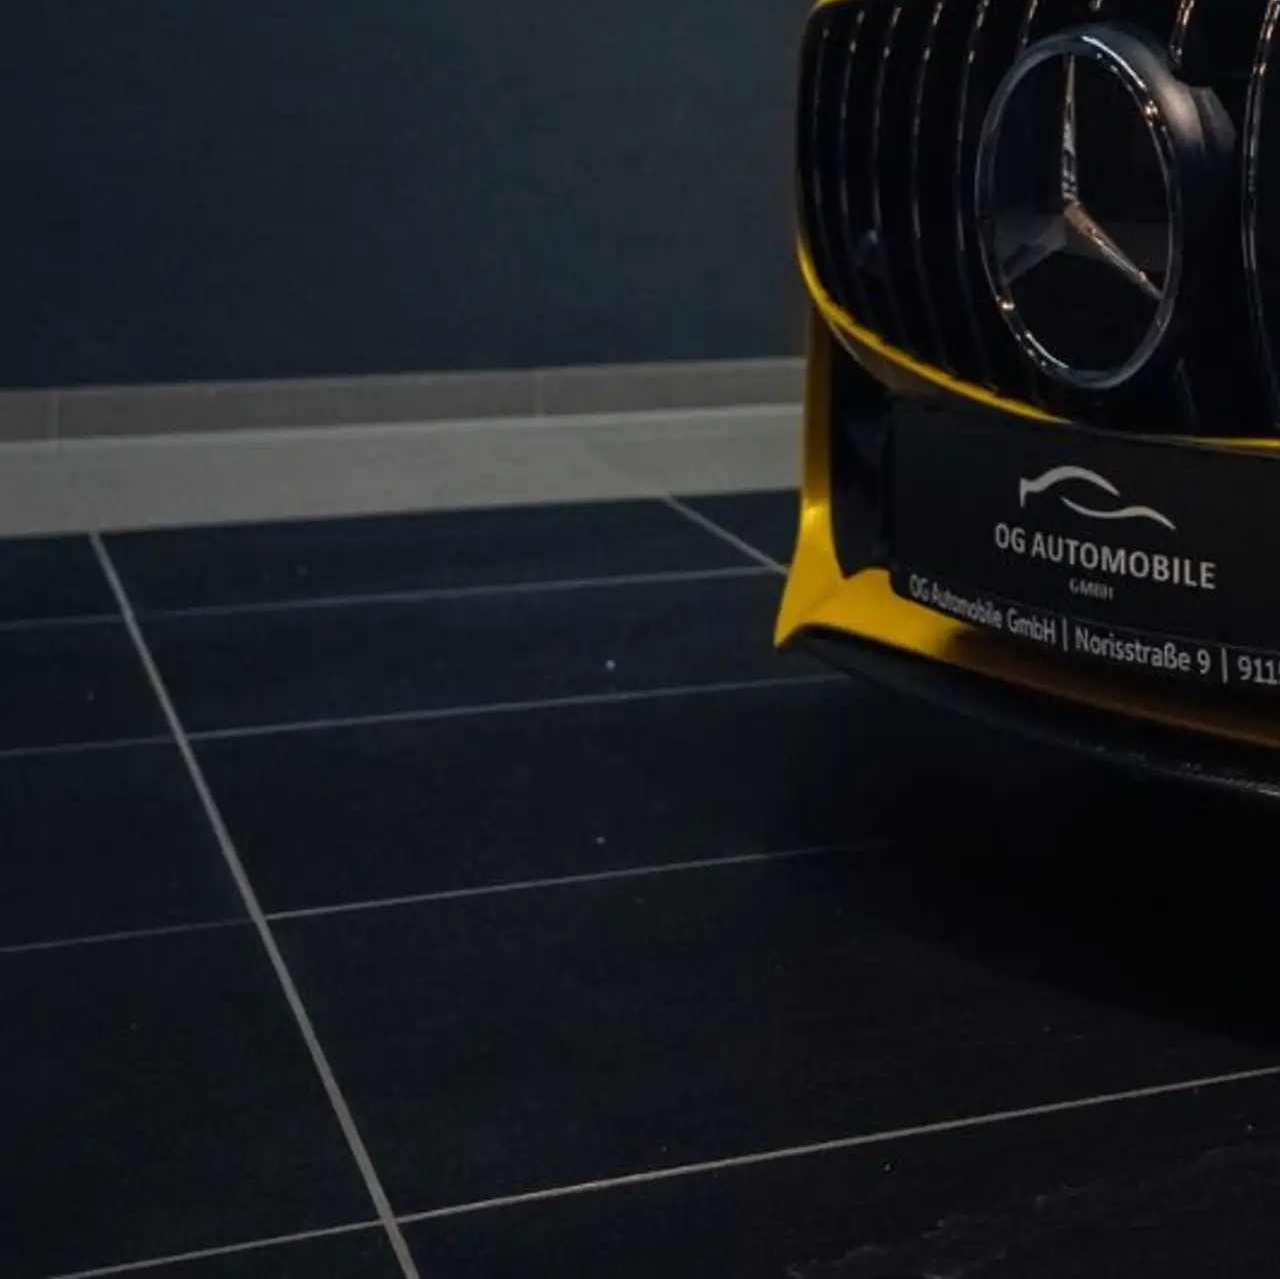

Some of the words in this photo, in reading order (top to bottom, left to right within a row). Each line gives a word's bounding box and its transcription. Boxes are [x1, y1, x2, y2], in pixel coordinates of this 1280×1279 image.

[994, 522, 1026, 554] OG
[1030, 531, 1216, 590] AUTOMOBILE
[909, 573, 930, 602] OG
[931, 582, 1003, 630] Automobile
[1006, 607, 1057, 644] GmbH
[1074, 626, 1192, 672] Norisstraße
[1196, 648, 1212, 675] 9
